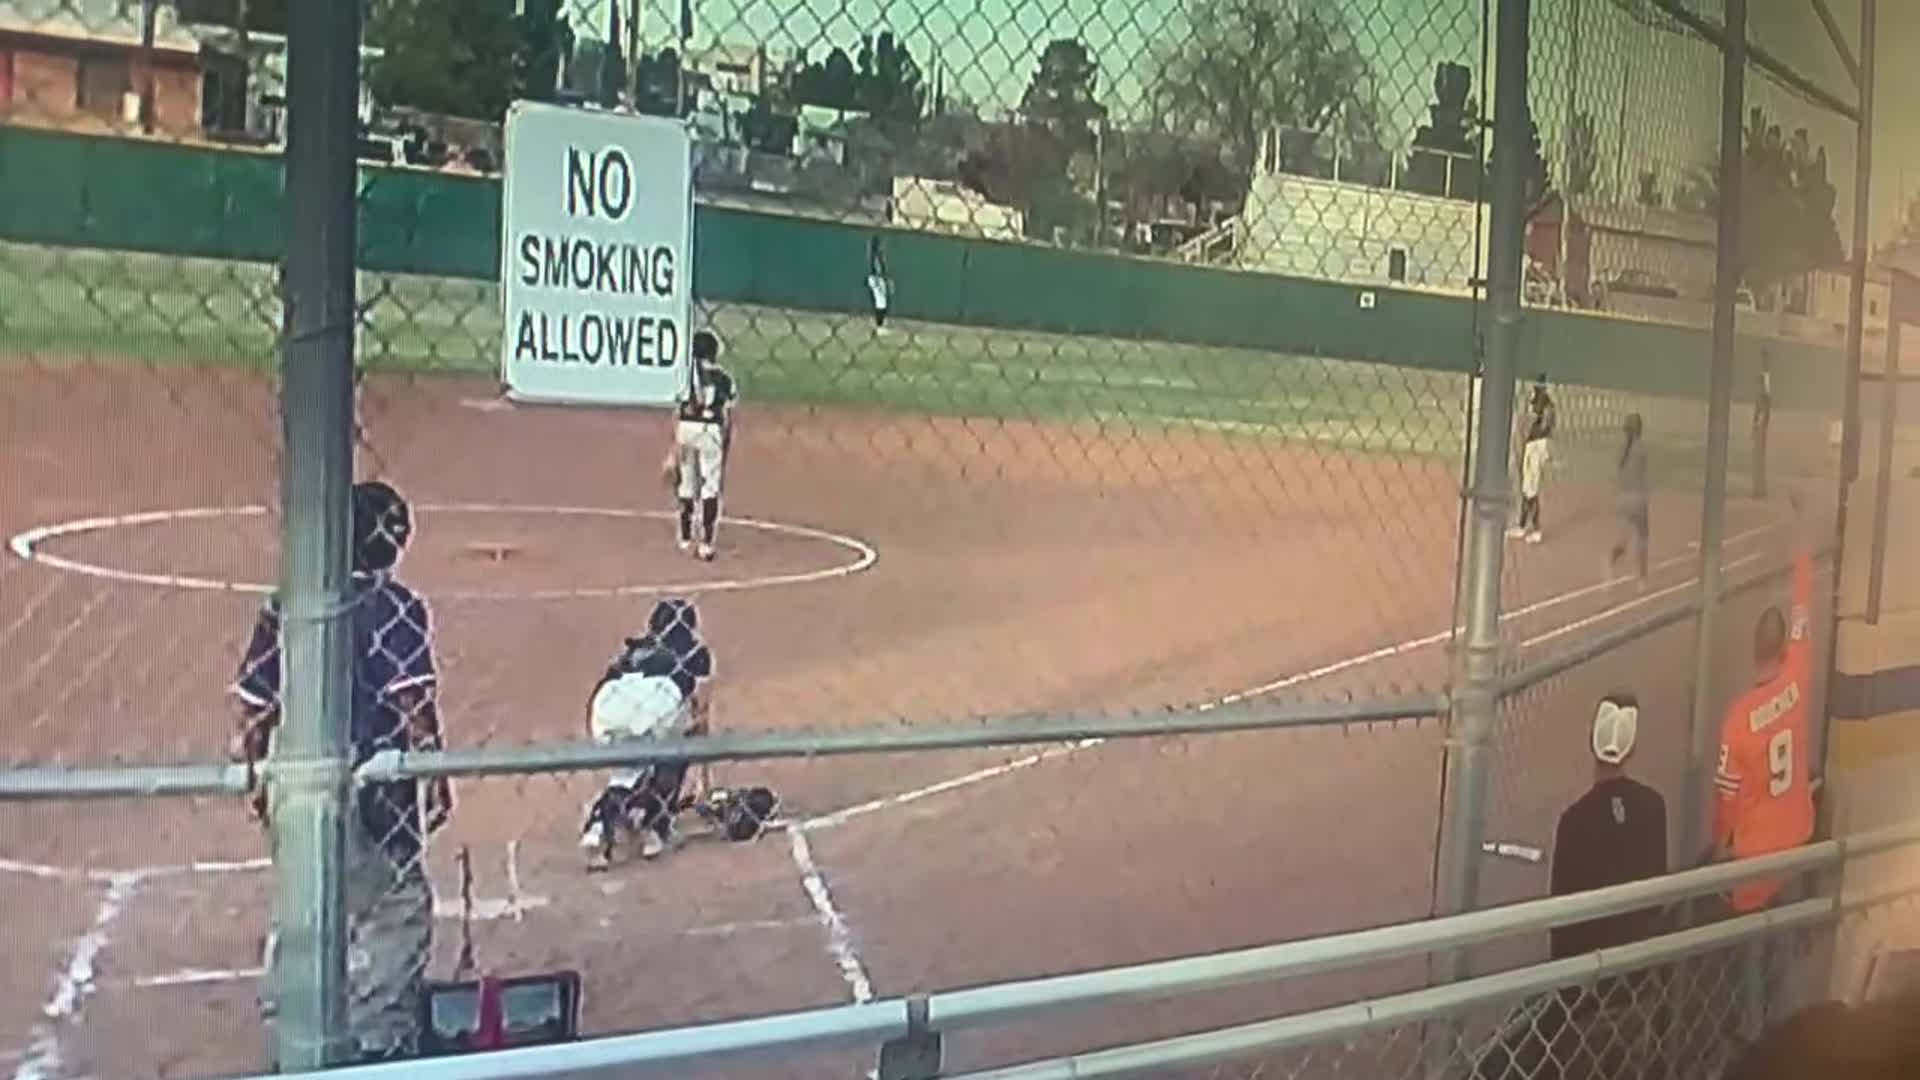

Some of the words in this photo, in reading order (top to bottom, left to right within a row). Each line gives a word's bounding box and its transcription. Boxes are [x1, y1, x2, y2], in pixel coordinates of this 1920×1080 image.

[567, 145, 632, 219] NO
[520, 234, 674, 296] SMOKING
[515, 309, 679, 367] ALLOWED
[1769, 728, 1793, 798] 9
